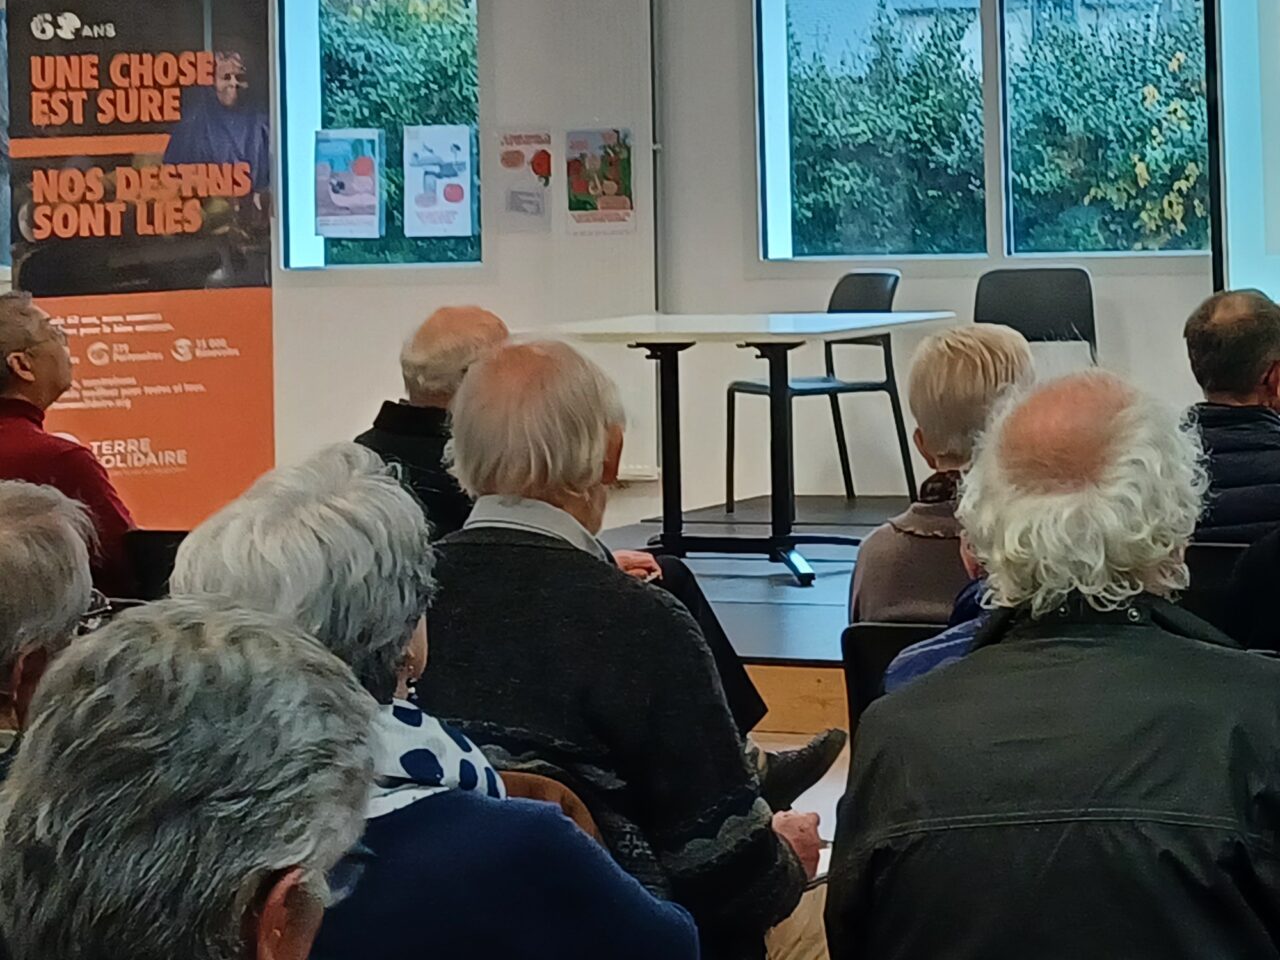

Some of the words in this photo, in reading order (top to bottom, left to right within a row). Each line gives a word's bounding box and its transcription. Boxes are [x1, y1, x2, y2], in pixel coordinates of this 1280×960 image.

[30, 54, 99, 90] UNE
[108, 50, 216, 88] CHOSE
[30, 90, 88, 126] EST
[96, 87, 181, 124] SURE
[32, 168, 105, 203] NOS
[32, 202, 126, 240] SONT
[136, 198, 202, 236] LIES
[90, 439, 152, 455] TERRE
